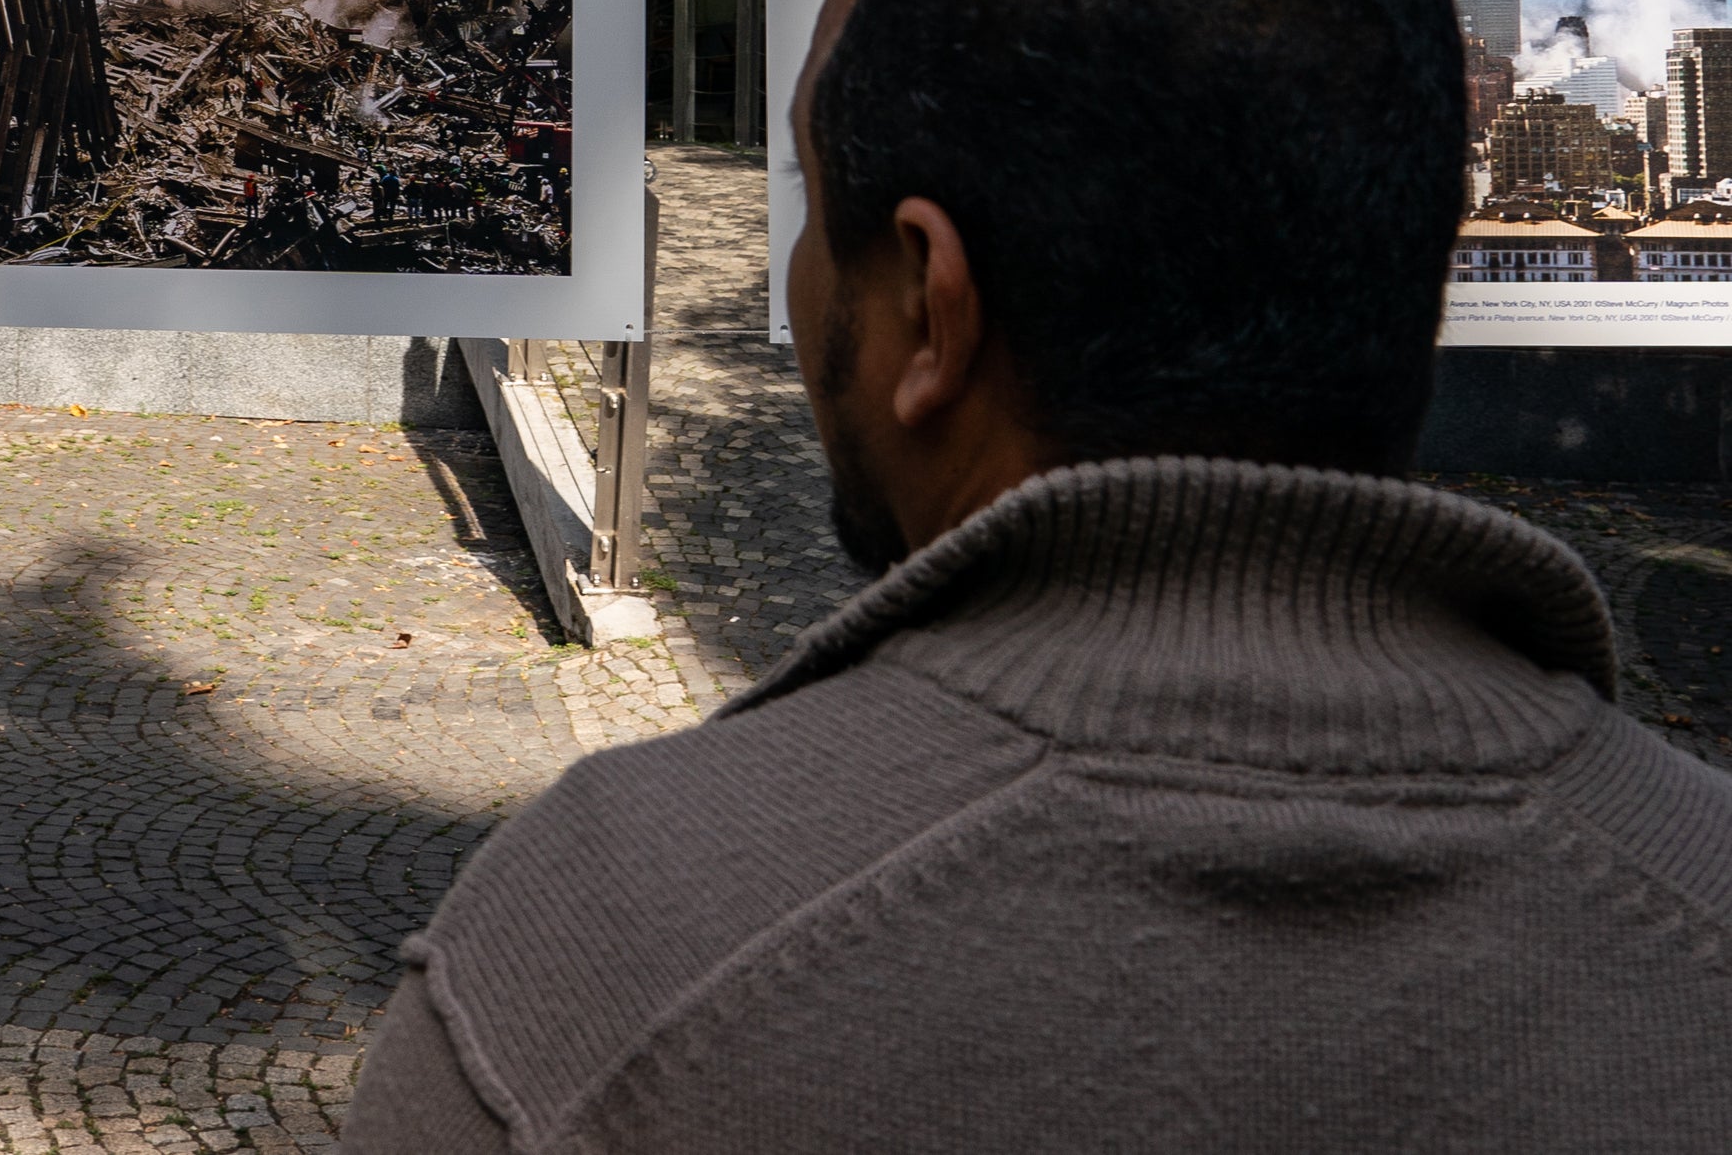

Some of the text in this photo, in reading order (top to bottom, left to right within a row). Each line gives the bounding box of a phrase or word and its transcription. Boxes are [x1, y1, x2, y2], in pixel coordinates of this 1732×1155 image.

[1625, 300, 1658, 308] McCurry
[1665, 300, 1700, 309] Magnum
[1701, 299, 1729, 307] Photos
[1468, 313, 1485, 321] Park
[1548, 313, 1566, 321] New
[1568, 313, 1584, 321] York
[1620, 313, 1637, 321] USA
[1639, 314, 1658, 322] 2001
[1691, 314, 1724, 323] McCurry
